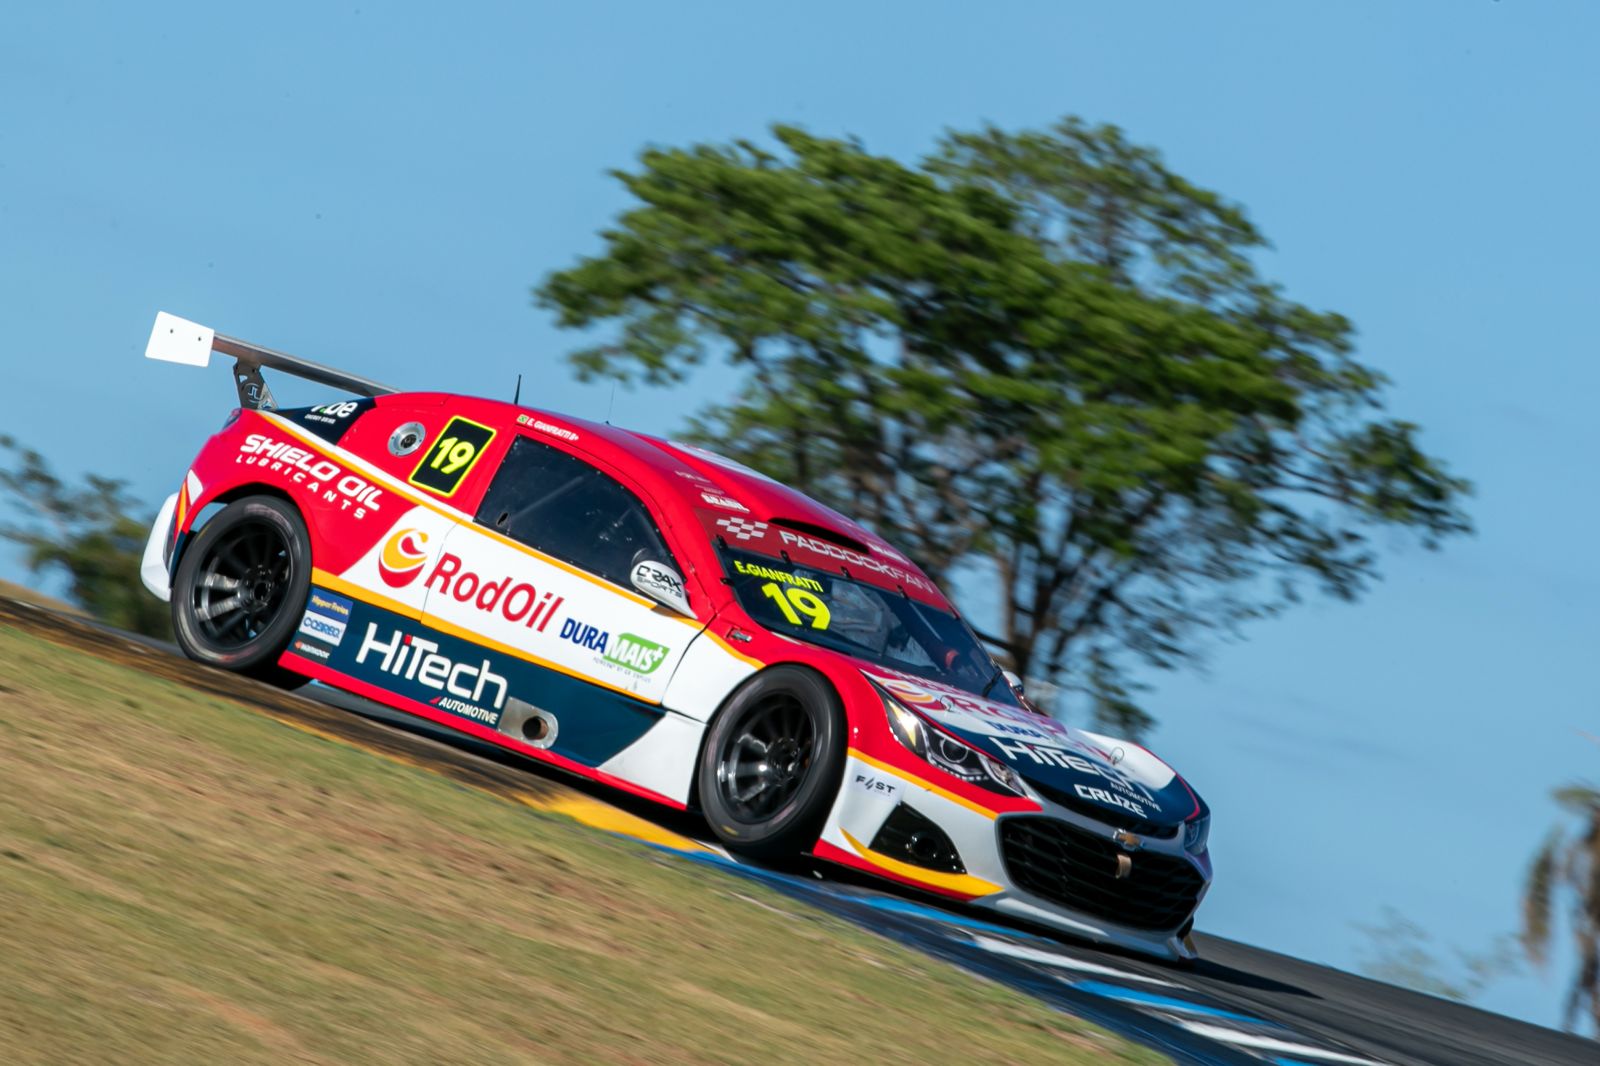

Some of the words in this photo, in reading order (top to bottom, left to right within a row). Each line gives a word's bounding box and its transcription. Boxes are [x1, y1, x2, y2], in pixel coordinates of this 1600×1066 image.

[240, 434, 341, 482] SHIELD
[336, 473, 384, 511] OIL
[430, 436, 476, 474] 19
[235, 453, 366, 520] LUBRICANTS
[424, 552, 565, 633] RodOil
[637, 575, 683, 598] SPORTS
[733, 559, 824, 593] E.GIANFRATTI
[761, 582, 831, 631] 19
[559, 616, 610, 654] DURA
[355, 621, 508, 710] HiTech
[438, 696, 500, 725] AUTOMOTIVE
[1073, 783, 1149, 819] CRUZE
[1110, 781, 1162, 813] AUTOMOTIVE
